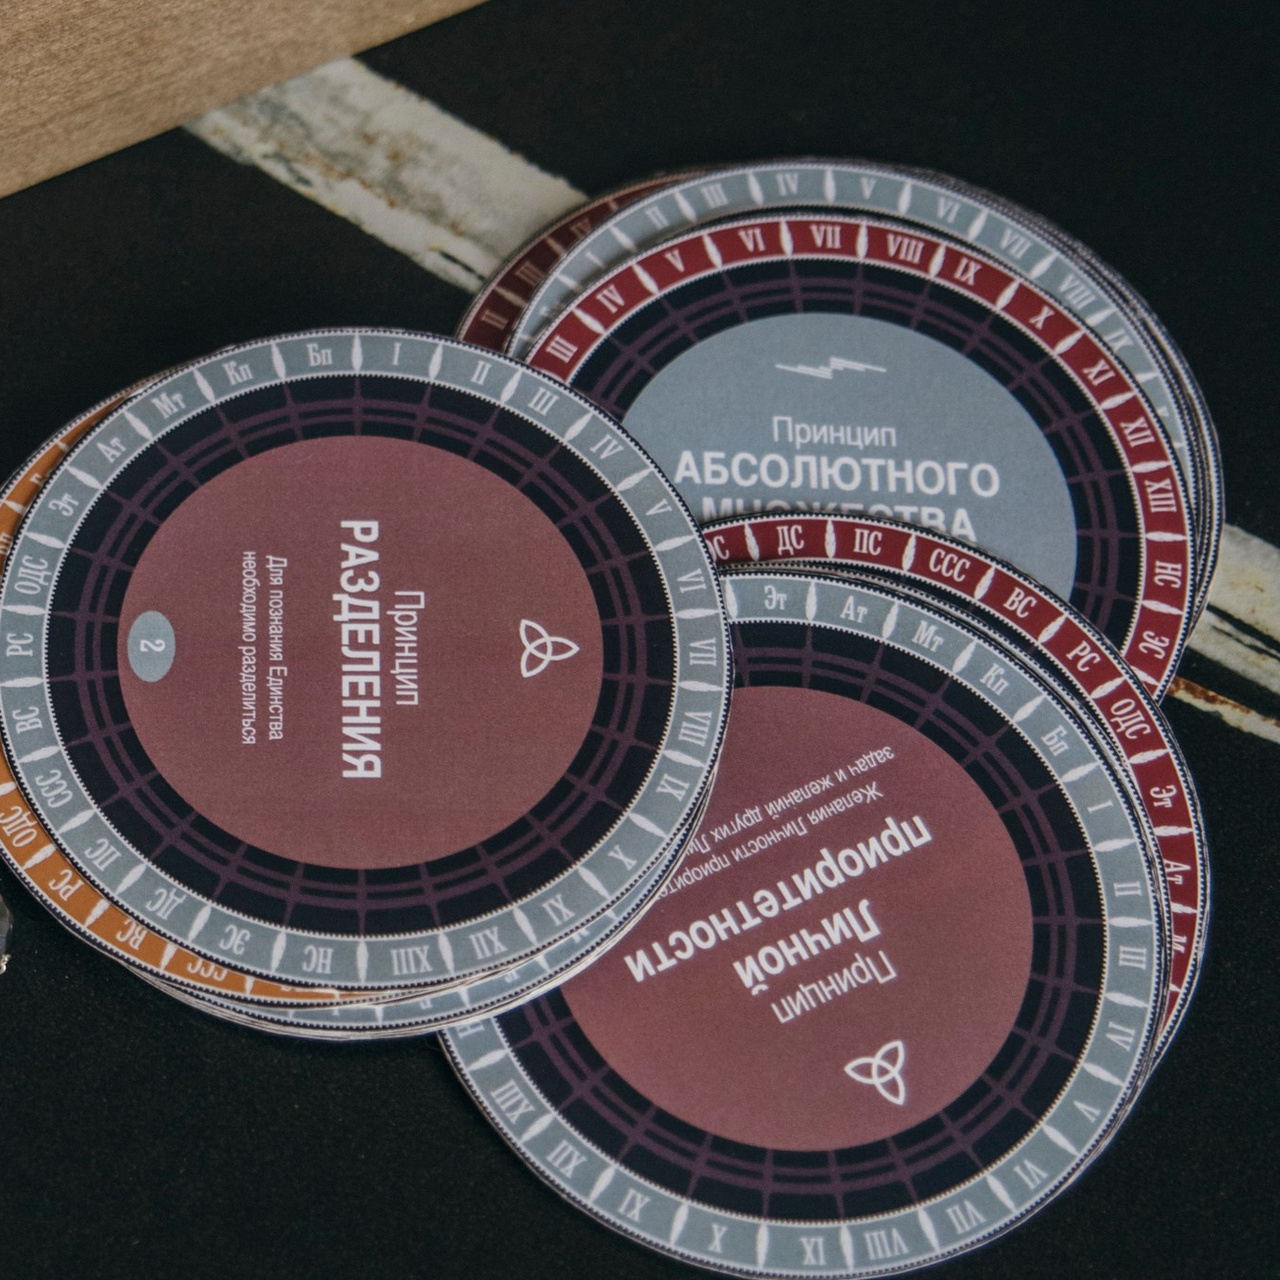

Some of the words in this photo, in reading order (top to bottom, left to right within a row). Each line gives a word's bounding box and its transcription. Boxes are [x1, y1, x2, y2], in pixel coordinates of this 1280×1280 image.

[646, 206, 669, 229] II
[700, 184, 728, 209] III
[776, 172, 799, 196] IV
[861, 178, 877, 199] V
[937, 196, 961, 222] VI
[999, 227, 1032, 257] VII
[1058, 276, 1097, 309] VIII
[471, 360, 492, 385] II
[546, 335, 578, 363] III
[597, 284, 626, 315] IV
[665, 247, 685, 273] V
[739, 227, 766, 252] VI
[810, 226, 842, 249] VII
[886, 234, 924, 265] VIII
[954, 257, 982, 285] IX
[1029, 306, 1055, 331] X
[1083, 358, 1116, 387] XI
[1121, 416, 1155, 447] XII
[1145, 478, 1177, 513] XIII
[528, 387, 558, 416] III
[590, 434, 624, 459] IV
[773, 416, 897, 450] Принцип
[674, 450, 1001, 498] АБСОЛЮТНОГО
[645, 499, 672, 517] V
[14, 554, 49, 595] ОДС
[265, 554, 288, 586] Для
[677, 569, 707, 593] VI
[1153, 560, 1182, 588] НС
[240, 551, 260, 643] необходимо
[268, 589, 283, 661] познания
[777, 525, 805, 556] ДС
[854, 528, 883, 556] ПС
[929, 548, 971, 583] ССС
[1003, 587, 1037, 619] ВС
[1066, 640, 1101, 672] РС
[1110, 698, 1151, 740] ОДС
[6, 632, 34, 656] РС
[139, 639, 166, 652] 2
[332, 520, 382, 778] РАЗДЕЛЕНИЯ
[386, 591, 425, 705] Принцип
[689, 638, 717, 666] VII
[1138, 630, 1169, 659] ЭС
[238, 646, 256, 744] разделиться
[266, 666, 288, 740] Единства
[12, 706, 43, 734] ВС
[679, 710, 709, 747] VIII
[837, 770, 848, 783] и
[849, 746, 895, 782] задач
[35, 769, 73, 808] ССС
[656, 773, 689, 802] IX
[765, 777, 835, 820] желаний
[810, 781, 884, 825] Желания
[709, 805, 763, 841] других
[85, 838, 121, 871] ПС
[685, 832, 711, 857] Ли
[731, 816, 809, 863] Личности
[608, 849, 637, 871] X
[48, 869, 83, 901] РС
[655, 852, 731, 901] приорите
[1113, 881, 1142, 897] II
[146, 887, 187, 920] ДС
[542, 895, 575, 926] XI
[624, 815, 933, 982] приоритетности
[220, 924, 251, 953] ЭС
[469, 927, 508, 959] XII
[732, 899, 881, 996] Личной
[302, 944, 334, 974] НС
[390, 946, 433, 975] XIII
[1119, 945, 1147, 970] III
[771, 950, 897, 1024] Принцип
[1106, 1021, 1136, 1051] IV
[490, 1079, 536, 1125] XIII
[1073, 1100, 1100, 1123] V
[546, 1139, 587, 1179] XII
[1014, 1159, 1049, 1190] VI
[619, 1188, 650, 1221] XI
[946, 1199, 986, 1235] VII
[708, 1224, 728, 1253] X
[800, 1236, 827, 1265] IX
[864, 1228, 909, 1260] VIII
